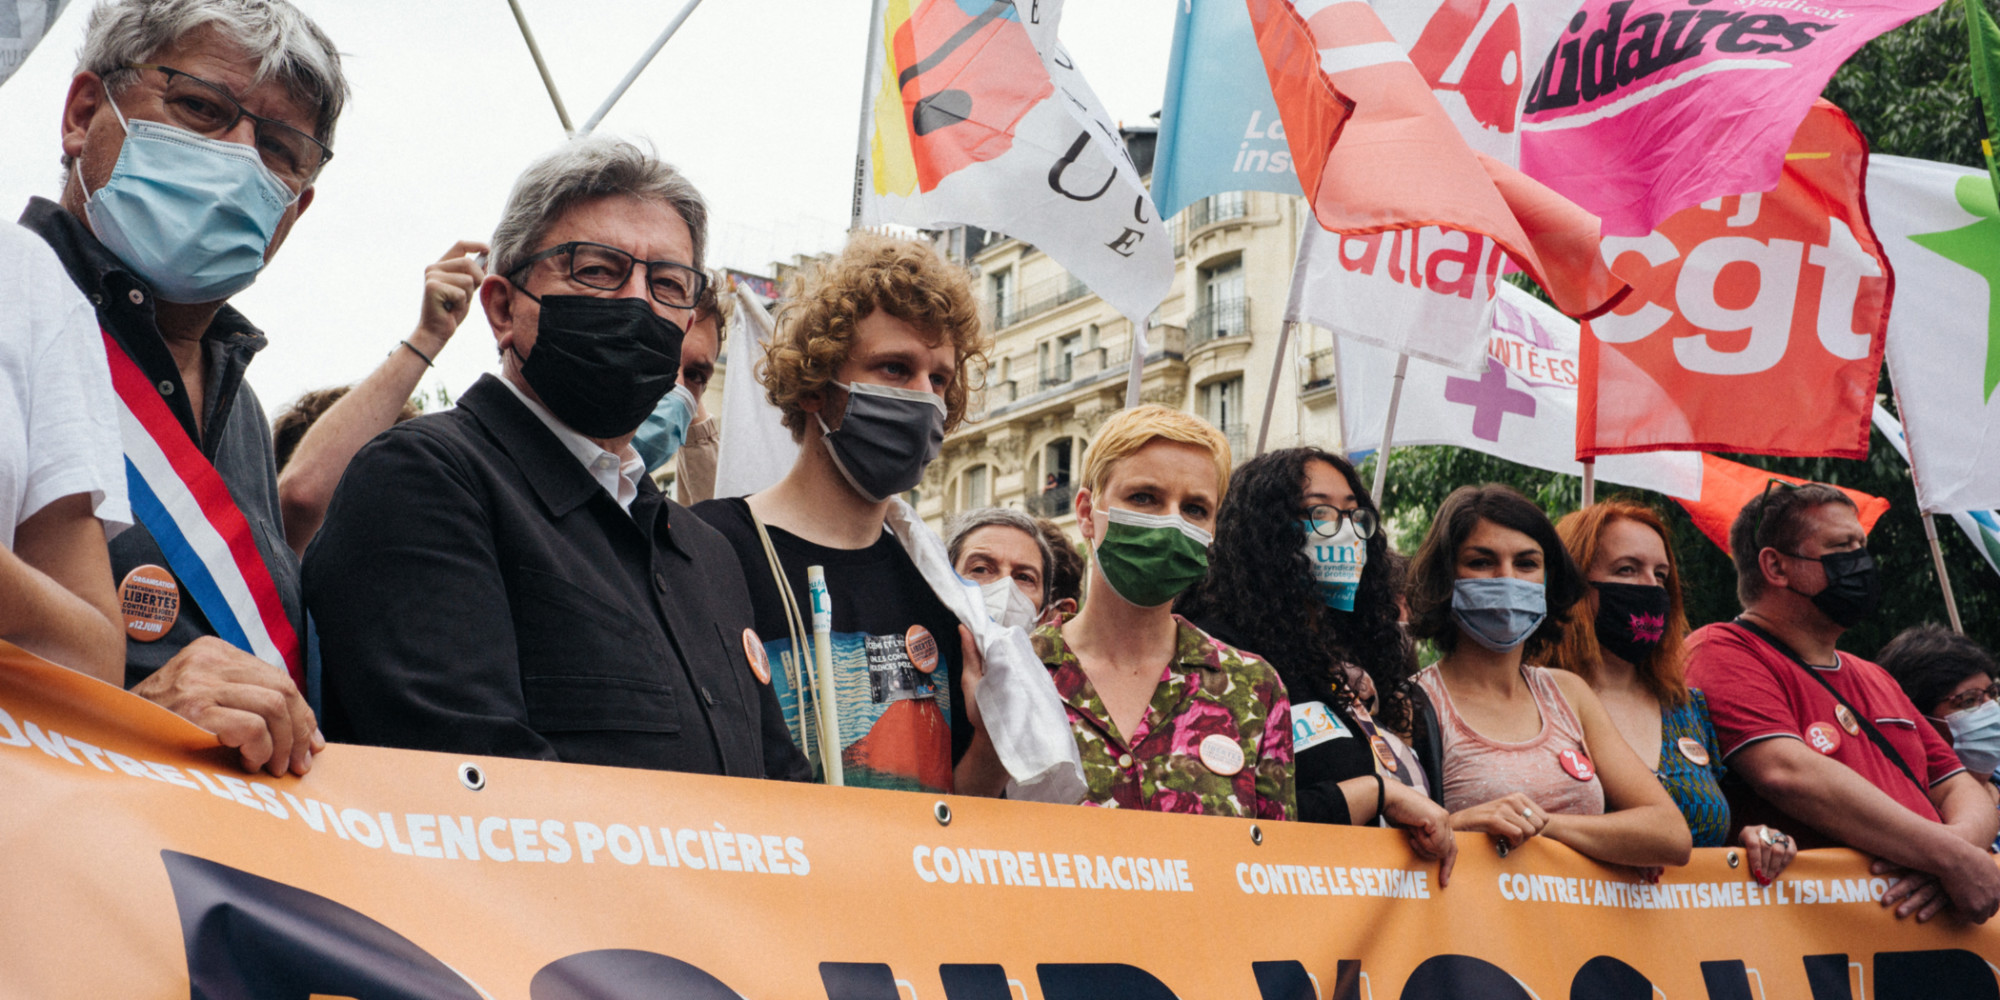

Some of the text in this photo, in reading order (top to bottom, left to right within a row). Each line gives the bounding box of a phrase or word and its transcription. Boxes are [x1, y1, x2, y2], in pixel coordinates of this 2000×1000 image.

[1523, 0, 1840, 115] lidaires
[1589, 216, 1882, 376] cgt
[1811, 727, 1835, 753] cgt
[186, 768, 290, 820] LES
[281, 790, 572, 863] VIOLENCES
[573, 821, 810, 876] POLICIÈRES
[913, 845, 1194, 892] CONTRE LE RACISME
[1235, 862, 1431, 899] CONTRE LE SEXISME
[1498, 873, 1583, 905] CONTRE
[1580, 878, 1746, 909] L'ANTISÉMITISME
[1746, 881, 1773, 906] ET
